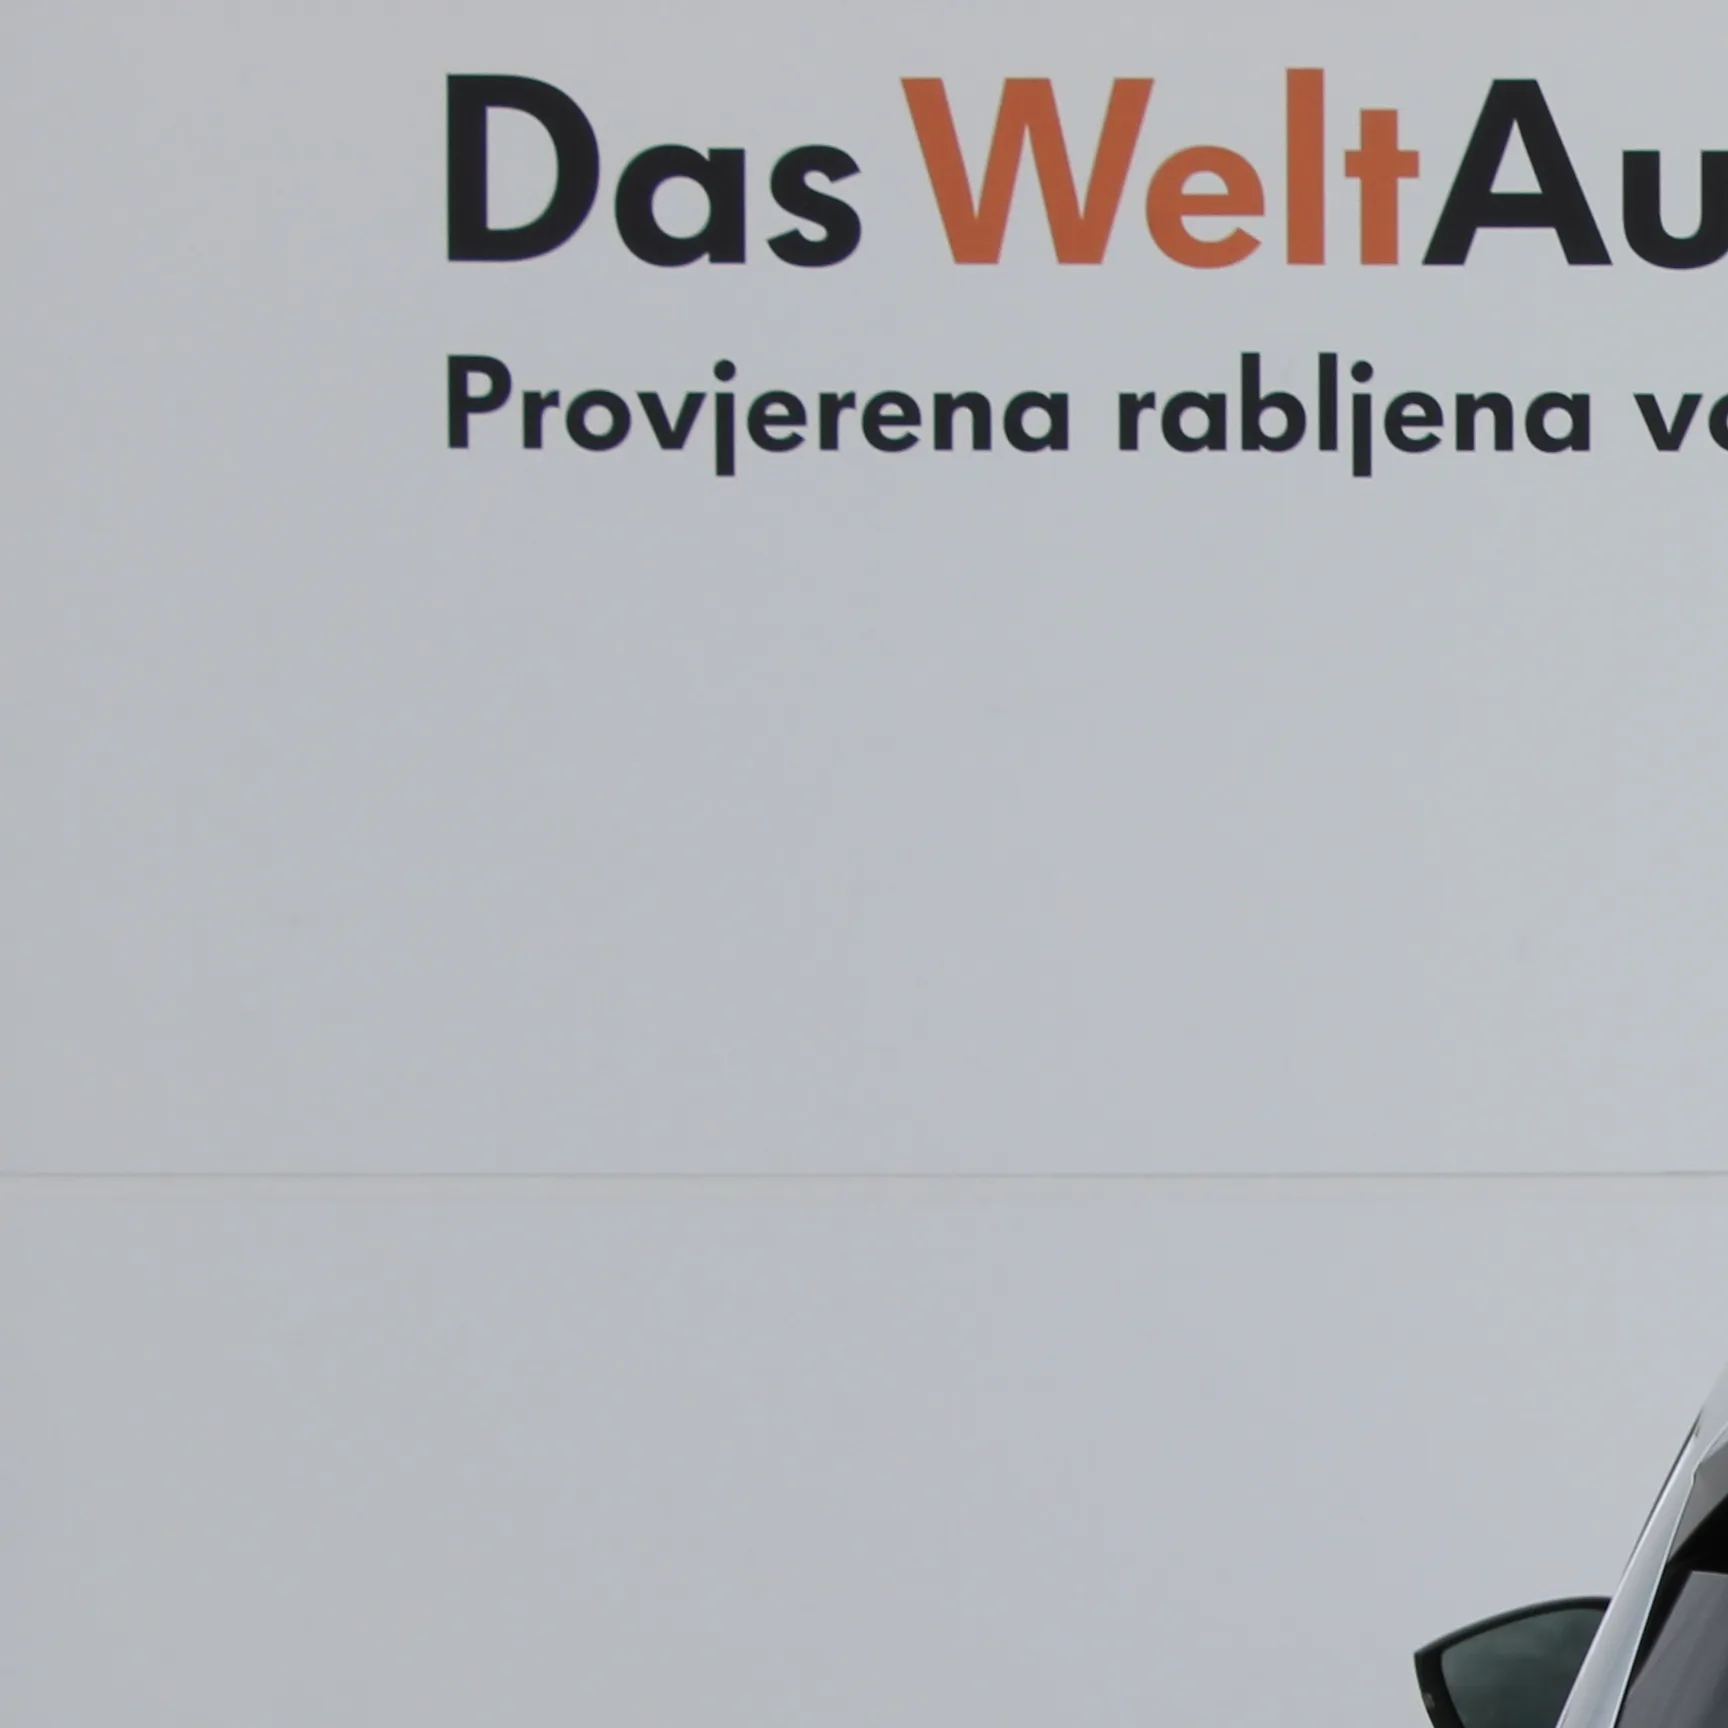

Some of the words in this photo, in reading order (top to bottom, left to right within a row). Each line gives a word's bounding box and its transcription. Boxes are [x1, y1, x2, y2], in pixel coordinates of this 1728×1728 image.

[447, 74, 861, 267] Das
[446, 354, 1069, 477] Provjerena
[1118, 351, 1591, 477] rabljena
